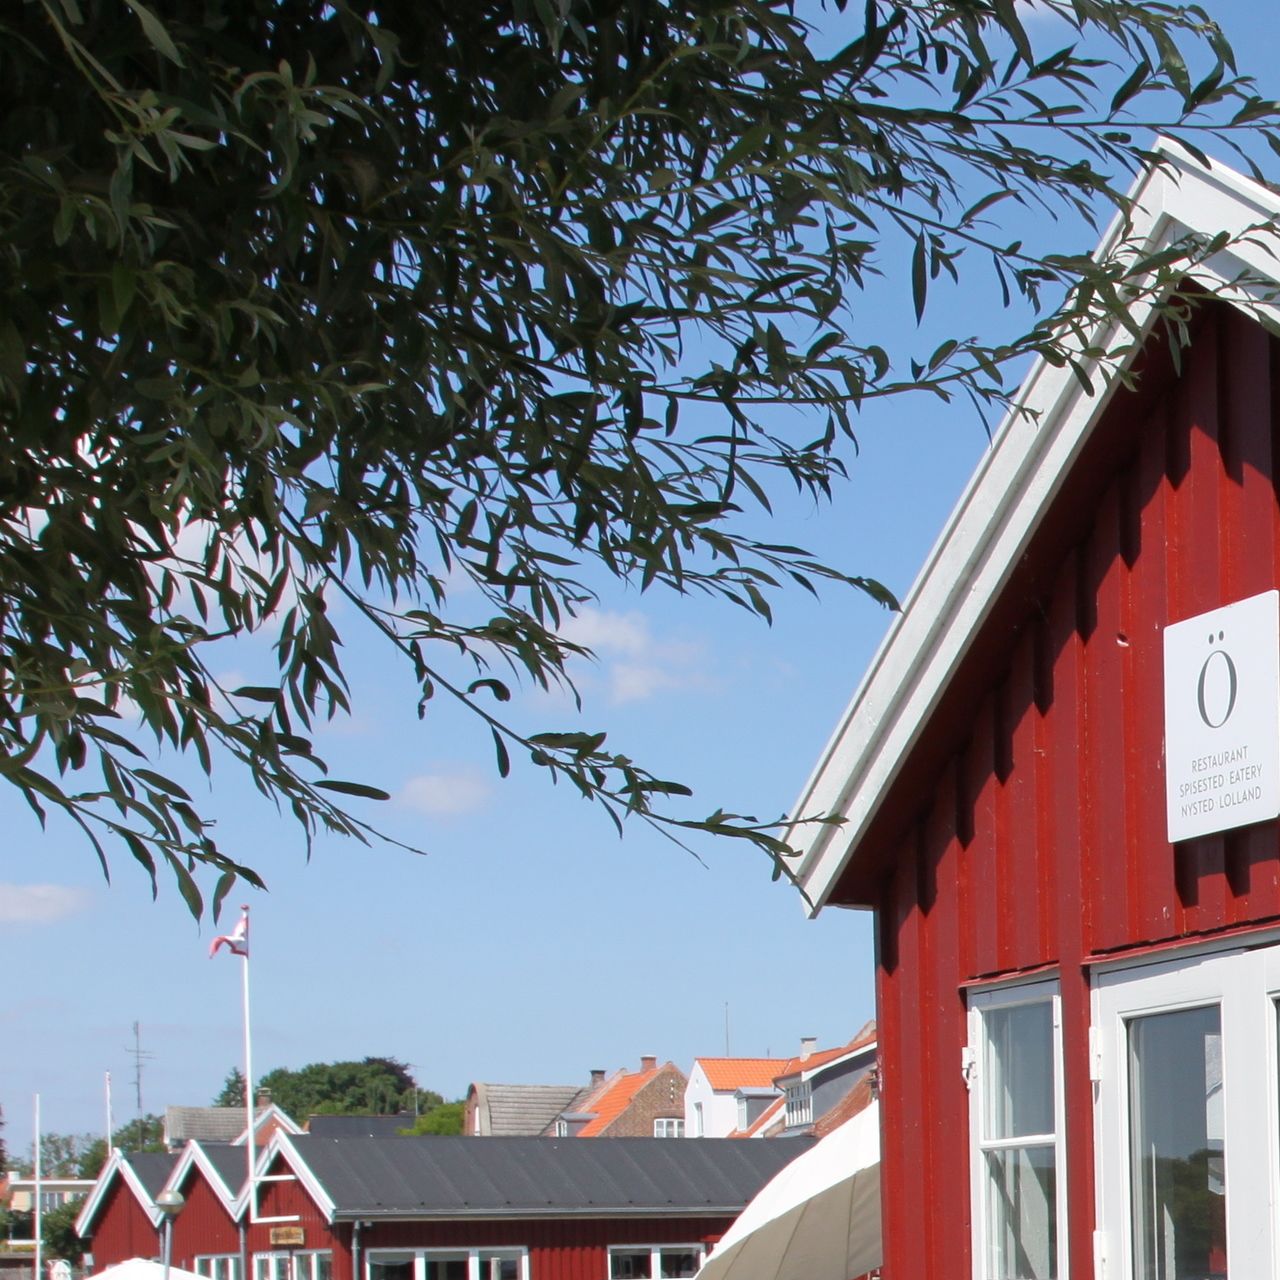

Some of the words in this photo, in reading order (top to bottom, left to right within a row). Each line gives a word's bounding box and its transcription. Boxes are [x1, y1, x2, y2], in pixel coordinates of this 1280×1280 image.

[1197, 630, 1238, 729] Ö
[1191, 745, 1249, 773] RESTAURANT
[1179, 774, 1225, 798] SPISESTED
[1229, 764, 1262, 785] EATERY
[1181, 798, 1215, 817] NYSTED
[1219, 786, 1262, 809] LOLLAND
